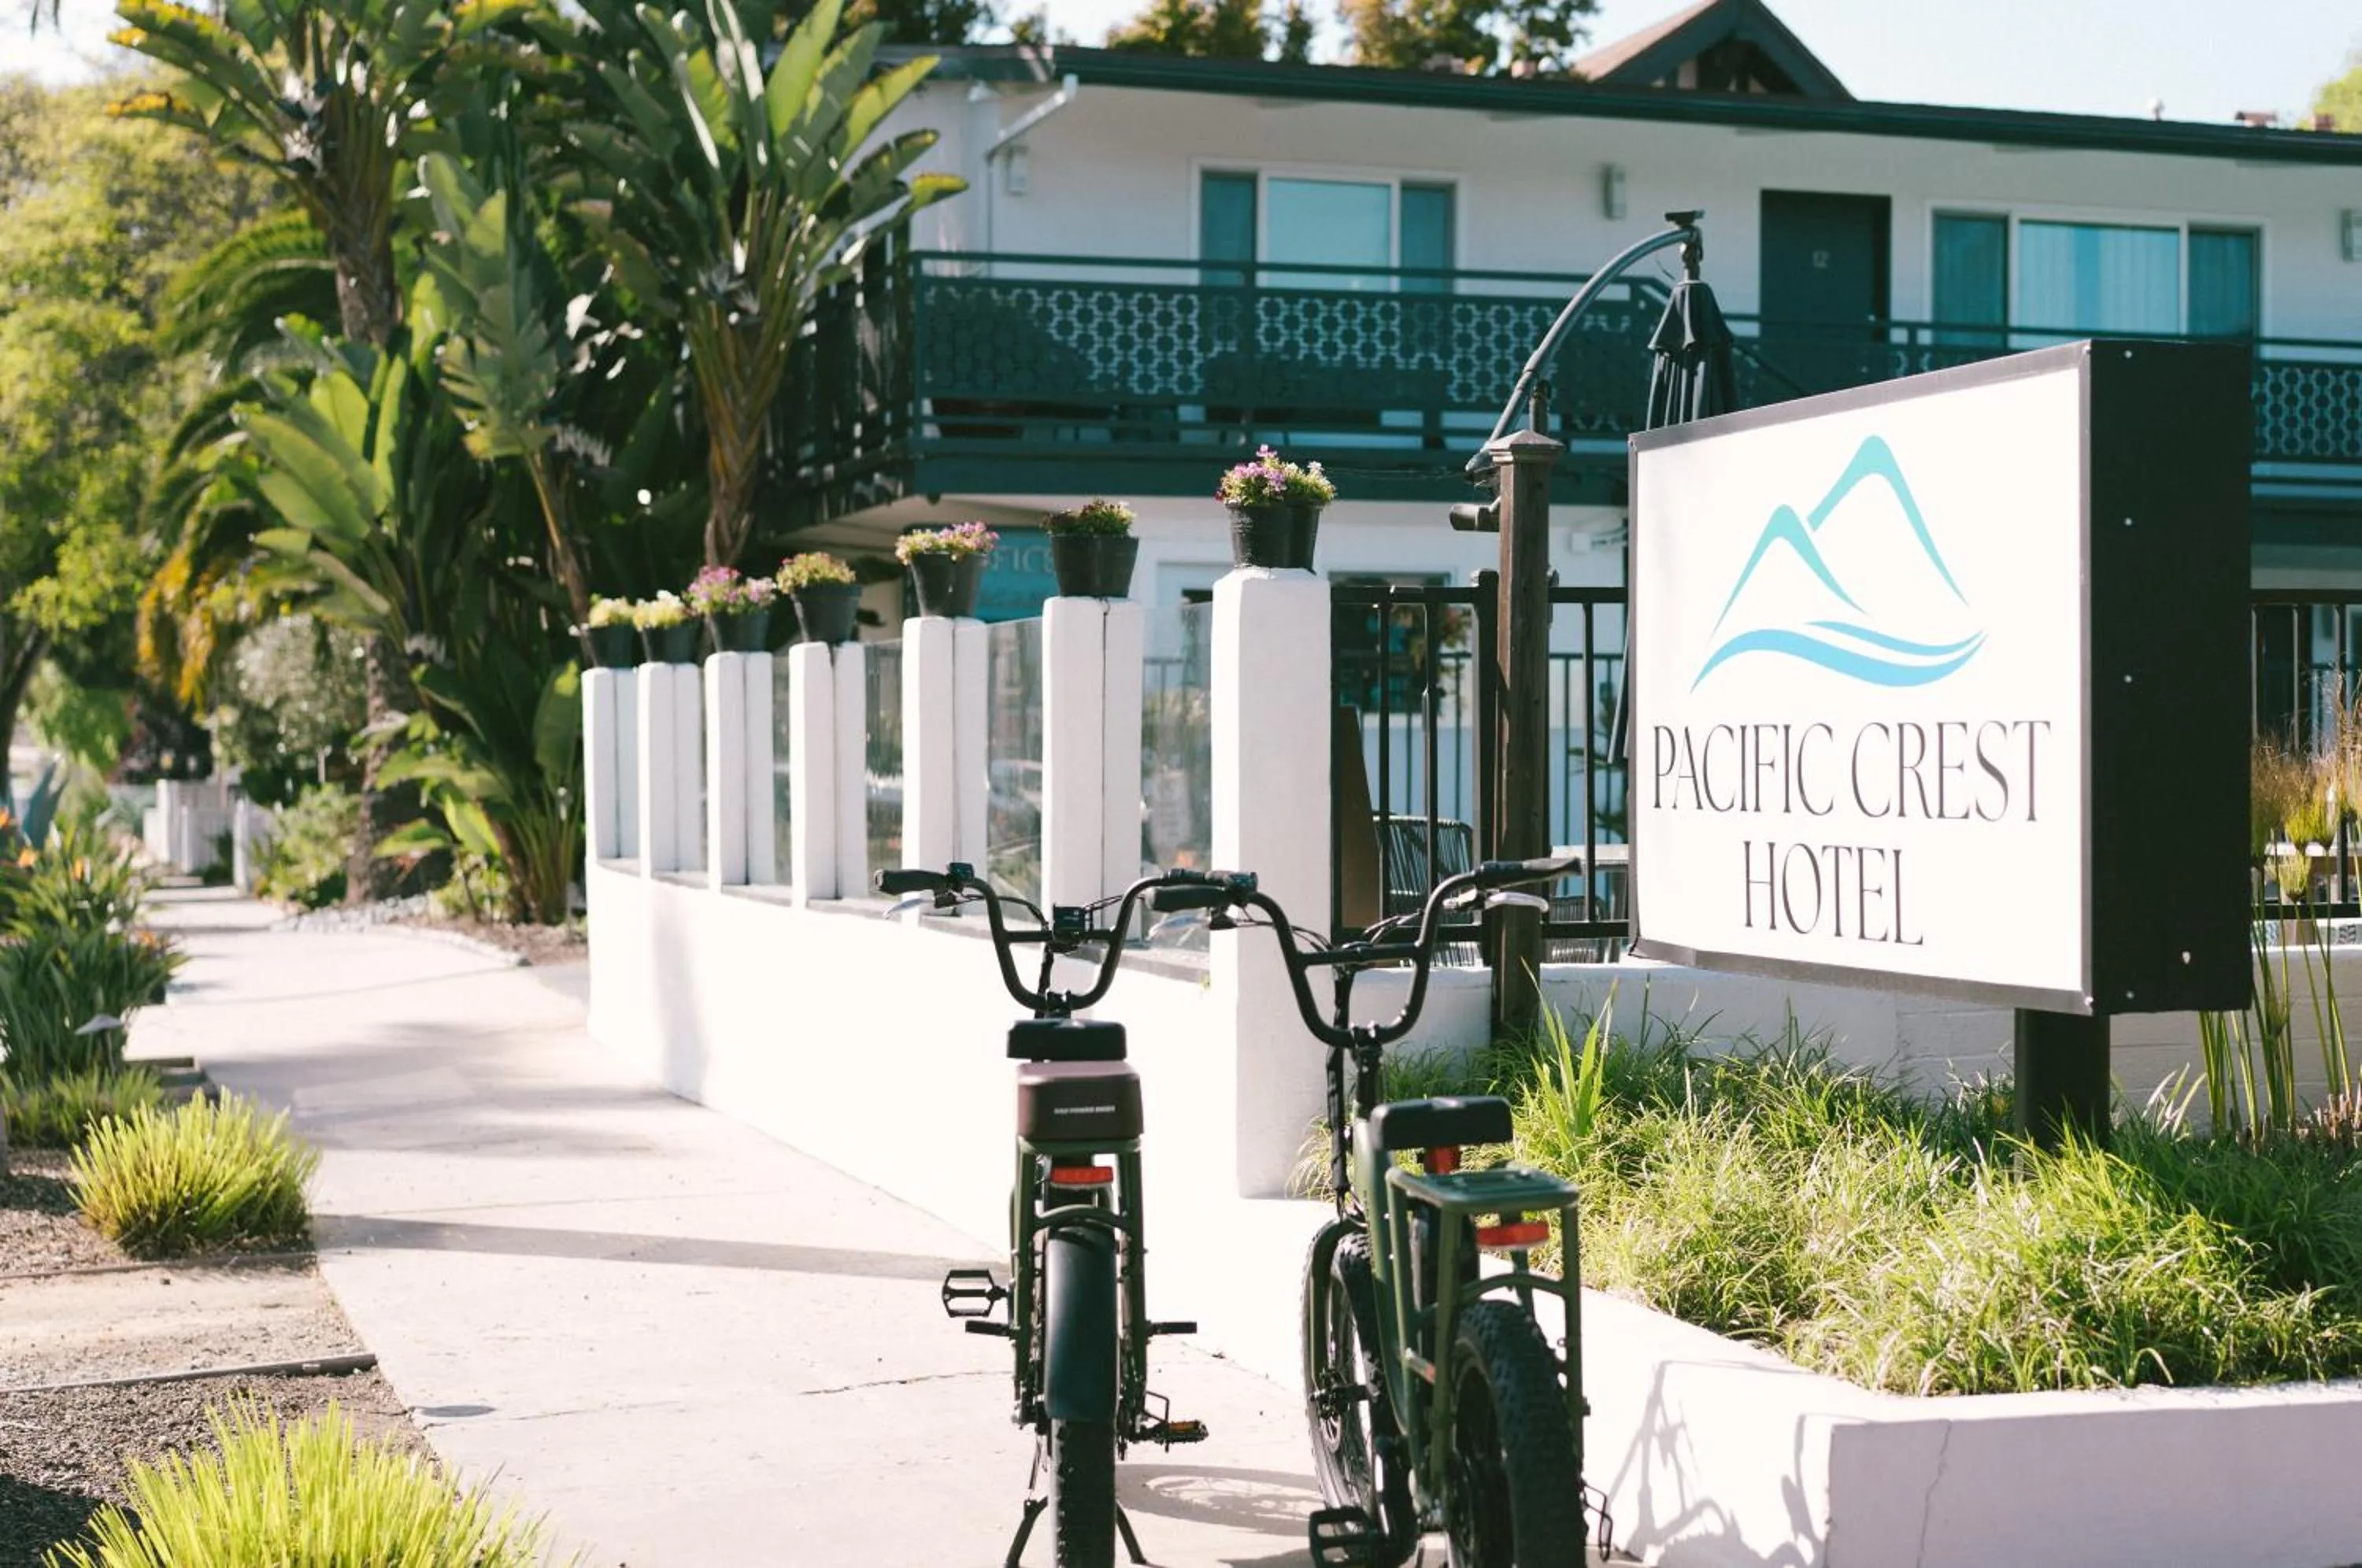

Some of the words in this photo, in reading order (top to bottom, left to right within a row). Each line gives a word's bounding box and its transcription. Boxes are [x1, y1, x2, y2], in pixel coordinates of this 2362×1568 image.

[1653, 723, 1834, 816] PACIFIC
[1851, 720, 2052, 822] CREST
[1742, 841, 1923, 945] HOTEL
